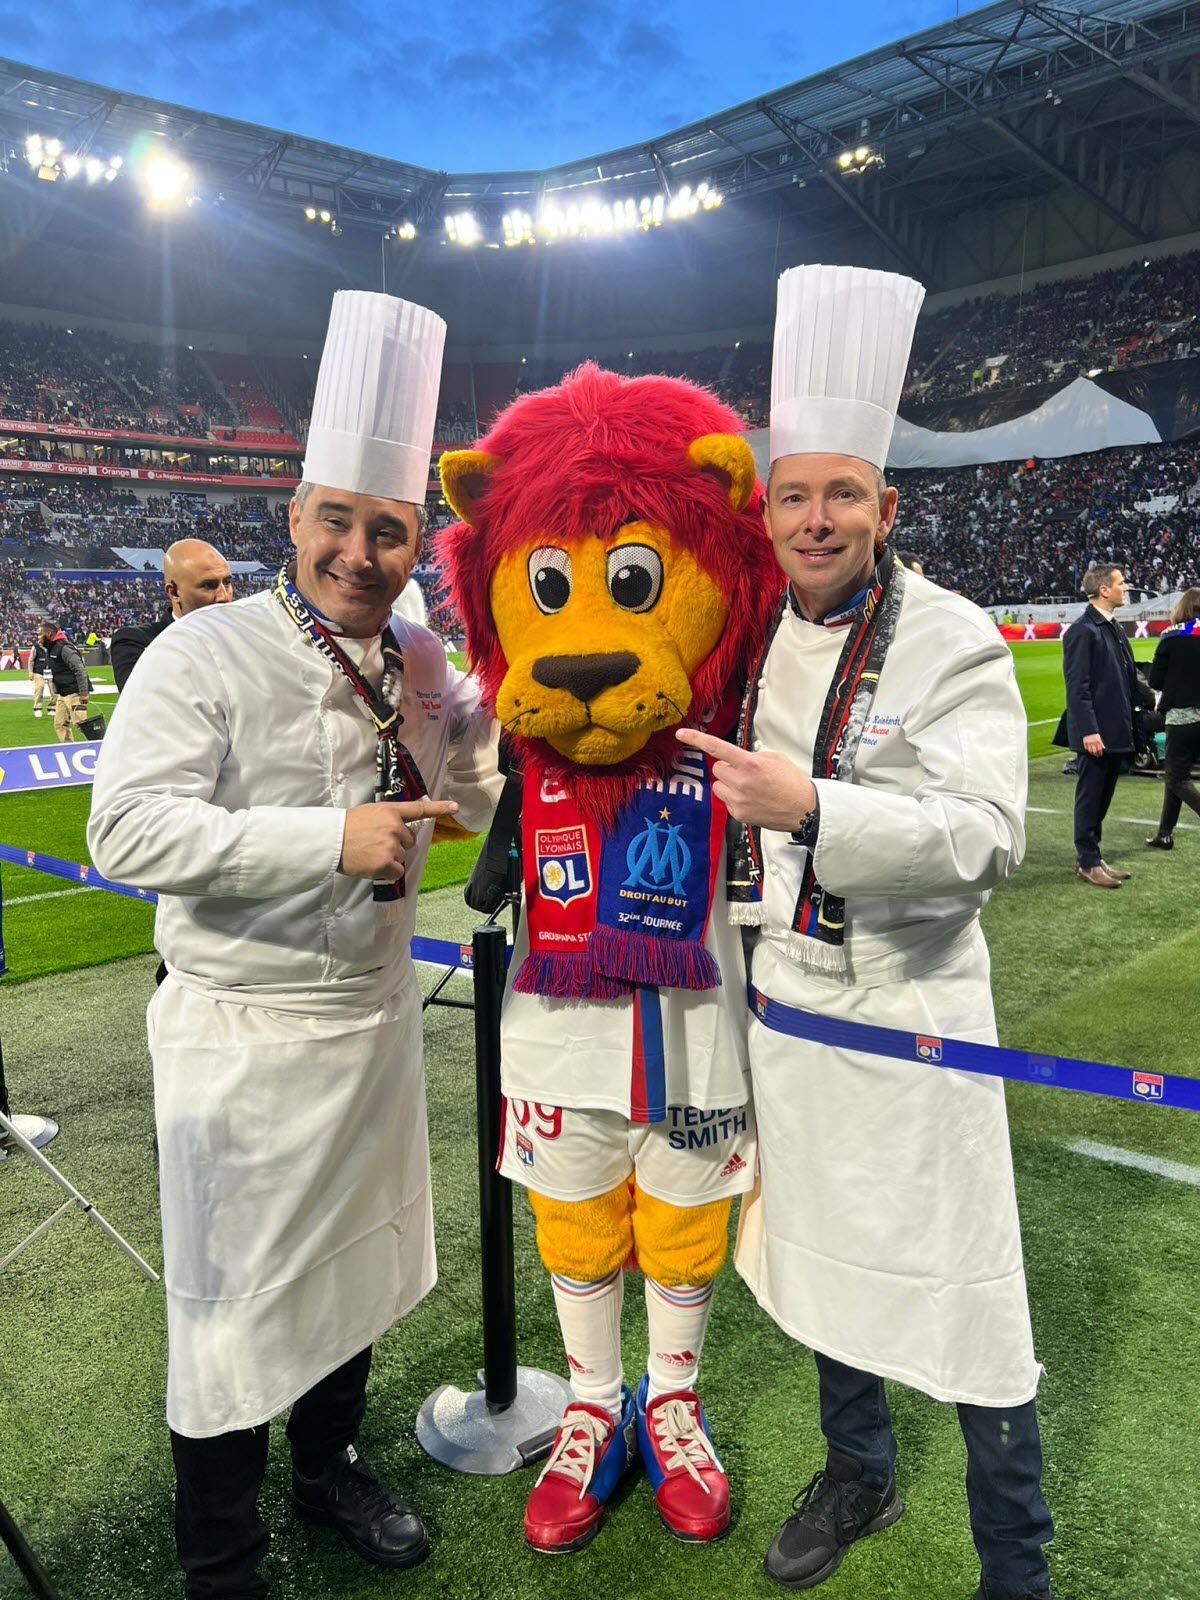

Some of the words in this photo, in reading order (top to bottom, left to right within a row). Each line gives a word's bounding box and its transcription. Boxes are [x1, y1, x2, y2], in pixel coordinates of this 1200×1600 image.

[58, 464, 88, 474] Orange
[101, 467, 130, 477] Orange
[540, 841, 583, 853] LYONNAIS
[542, 859, 586, 891] OL
[619, 889, 652, 901] DROIT
[652, 894, 667, 903] AU
[667, 895, 689, 908] BUT
[641, 915, 684, 931] JOURNÉE
[919, 1045, 939, 1058] OL
[1136, 1082, 1160, 1096] OL
[668, 1111, 747, 1150] SMITH
[720, 1160, 747, 1177] adidas
